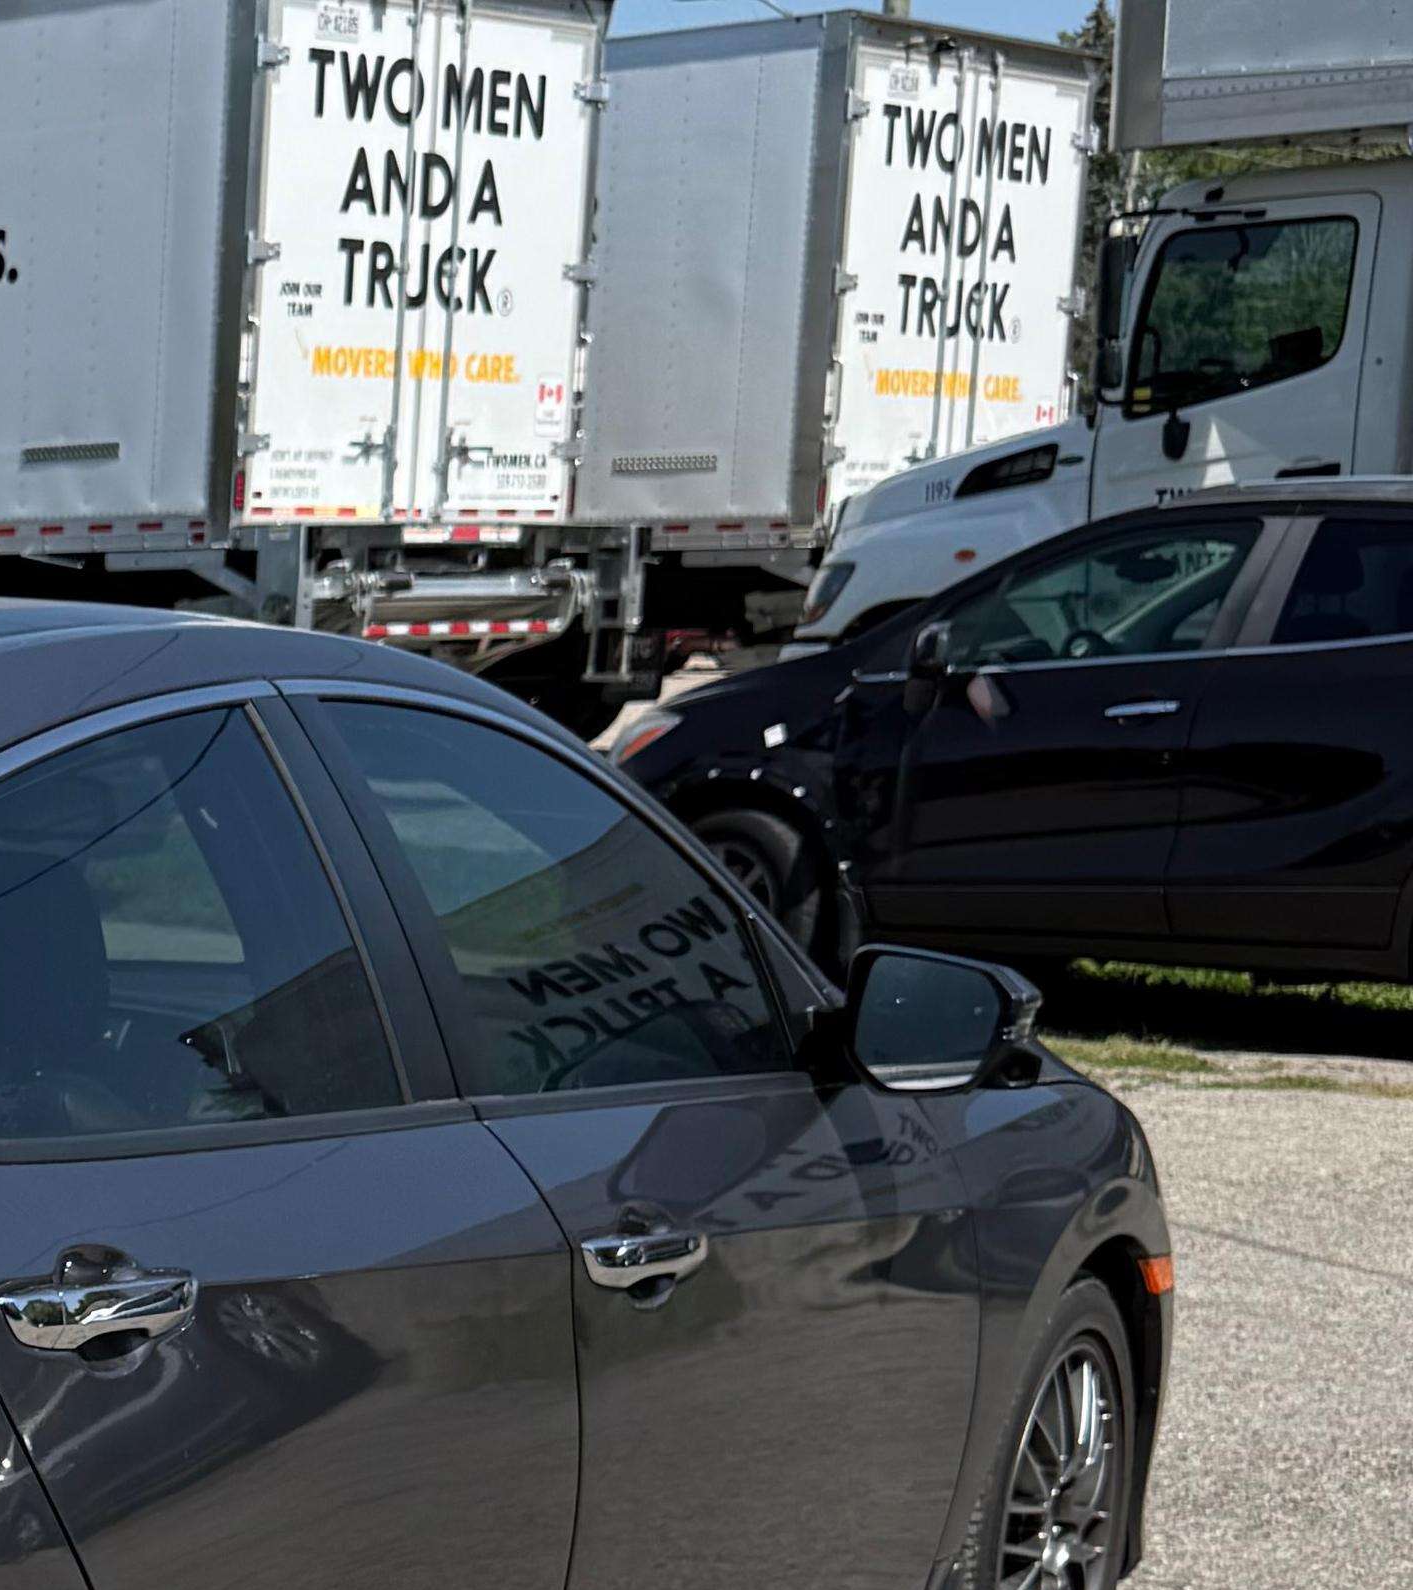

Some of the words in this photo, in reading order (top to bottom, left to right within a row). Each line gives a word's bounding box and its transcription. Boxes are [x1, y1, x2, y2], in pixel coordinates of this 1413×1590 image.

[309, 48, 424, 128] TWO
[442, 63, 546, 140] MEN
[884, 103, 964, 175] TWO
[976, 117, 1051, 185] MEN
[340, 146, 454, 220] AND
[467, 159, 502, 226] A
[900, 193, 981, 257] AND
[991, 203, 1015, 263] A
[339, 238, 496, 315] TRUCK
[898, 274, 1010, 342] TRUCK
[465, 352, 520, 383] CARE.
[925, 480, 951, 503] 1195
